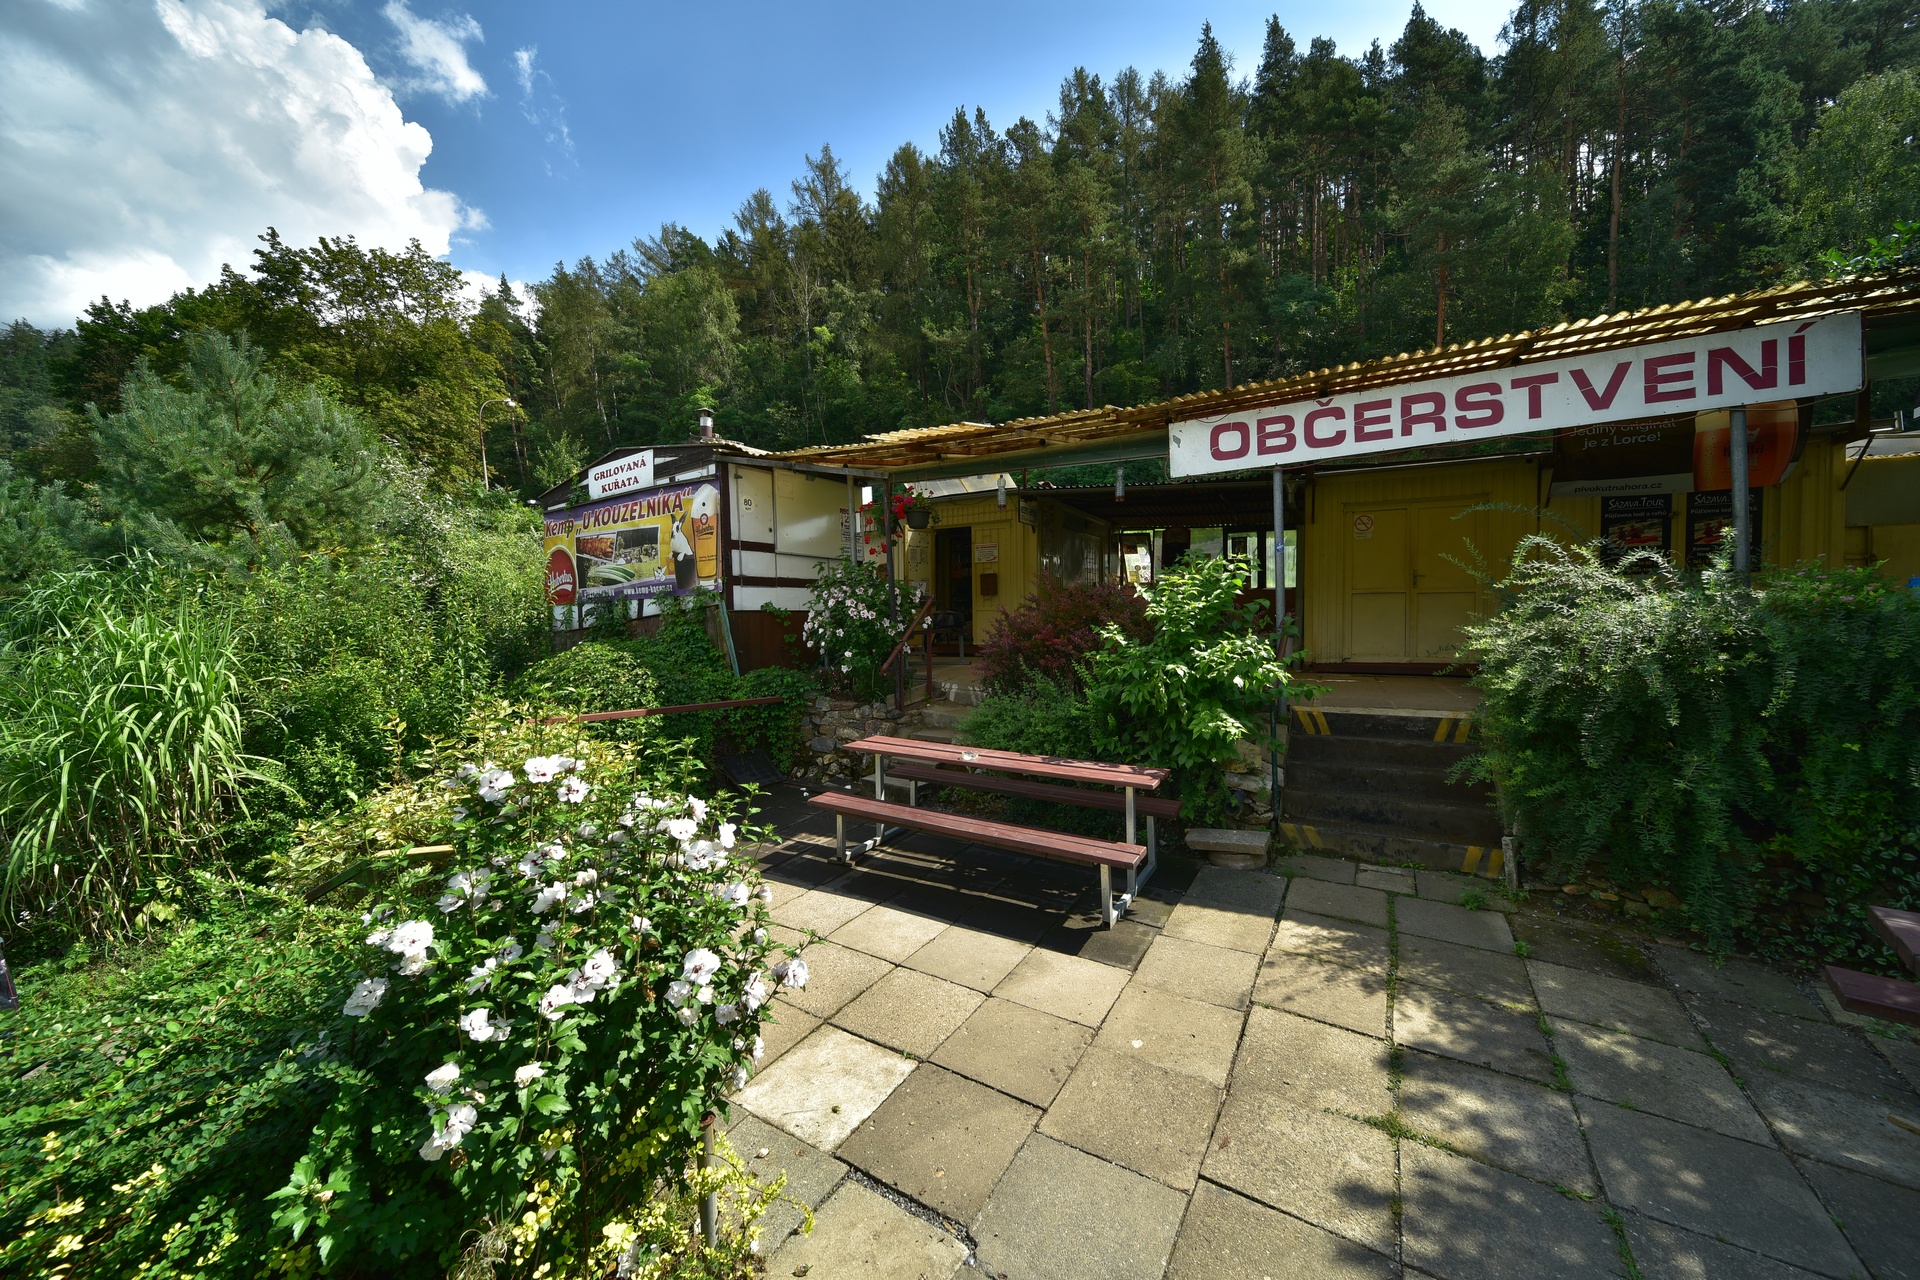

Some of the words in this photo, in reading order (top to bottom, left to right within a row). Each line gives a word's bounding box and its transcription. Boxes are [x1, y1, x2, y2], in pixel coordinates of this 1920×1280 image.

[1209, 321, 1818, 462] OBČERSTVENÍ
[1582, 438, 1597, 451] je
[1601, 438, 1609, 447] z
[1613, 431, 1661, 446] Lorce!
[594, 455, 647, 482] GRILOVANÁ
[601, 475, 640, 494] KUŘATA
[1574, 482, 1662, 494] pivokutnahora.cz
[743, 498, 753, 507] 80
[545, 517, 575, 538] Kemp
